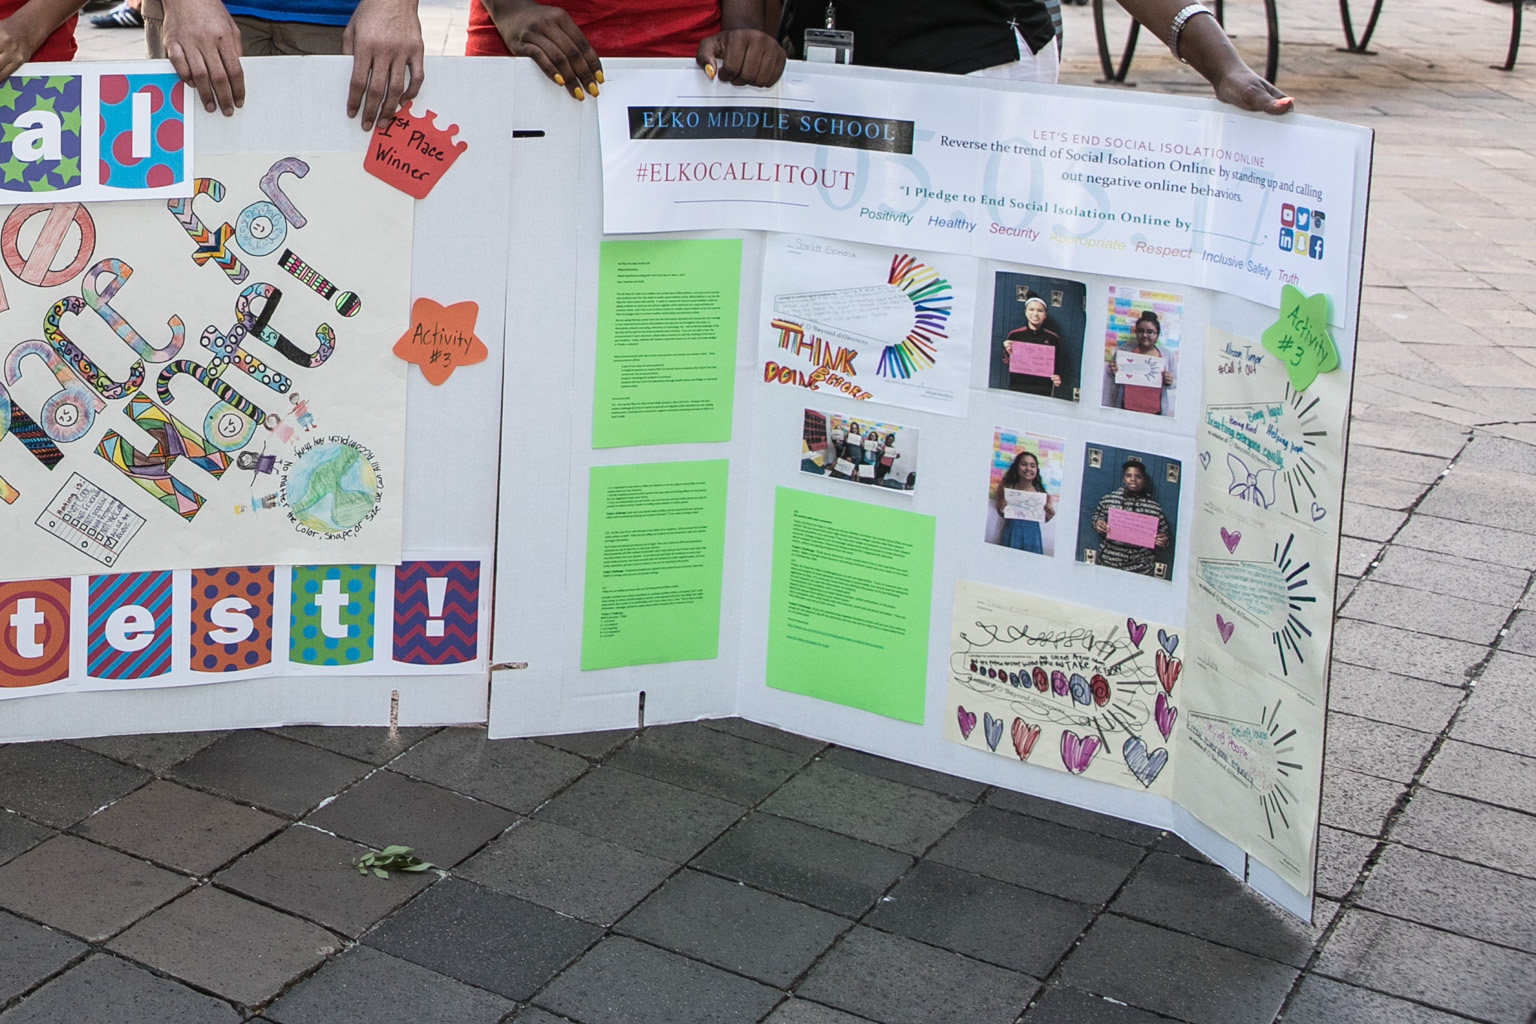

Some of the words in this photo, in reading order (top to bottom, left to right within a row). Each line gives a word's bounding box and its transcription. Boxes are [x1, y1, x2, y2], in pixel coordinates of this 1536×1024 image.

[378, 115, 410, 138] 1st
[407, 129, 444, 161] Place
[642, 110, 700, 128] ELKO
[707, 111, 790, 130] MIDDLE
[799, 115, 895, 142] SCHOOL
[375, 142, 431, 181] Winner
[1033, 129, 1068, 143] LET'S
[1073, 133, 1100, 146] END
[1105, 137, 1155, 152] SOCIAL
[1160, 142, 1232, 161] ISOLATION
[1234, 151, 1265, 168] ONLINE
[636, 161, 856, 192] #ELKOCALLITOUT
[940, 135, 988, 151] Reverse
[990, 140, 1011, 153] the
[1014, 145, 1046, 158] trend
[1049, 146, 1064, 159] of
[1065, 148, 1104, 164] Social
[1107, 153, 1166, 170] Isolation
[1169, 159, 1216, 176] Online
[1218, 165, 1230, 181] by
[1231, 169, 1266, 189] standing
[1267, 179, 1278, 192] up
[1279, 179, 1295, 193] and
[1295, 185, 1323, 203] calling
[1061, 171, 1083, 182] out
[1086, 174, 1141, 189] negative
[1144, 180, 1187, 194] online
[1190, 183, 1243, 203] behaviors.
[914, 187, 959, 203] Pledge
[963, 194, 976, 203] to
[980, 194, 1005, 207] End
[1009, 198, 1048, 213] Social
[1053, 204, 1116, 221] Isolation
[1121, 211, 1171, 228] Online
[859, 207, 914, 226] Positivity
[928, 215, 977, 233] Healthy
[989, 222, 1040, 242] Security
[1048, 231, 1126, 251] Appropriate
[1135, 241, 1193, 260] Respect
[1201, 250, 1244, 270] Inclusive
[1246, 260, 1272, 281] Safety
[1278, 269, 1300, 285] Truth
[411, 321, 473, 356] Activity
[770, 318, 859, 377] THINK
[1287, 304, 1329, 366] Activity
[429, 348, 452, 368] #3
[283, 460, 293, 472] No
[280, 475, 290, 508] matter
[286, 511, 297, 524] the
